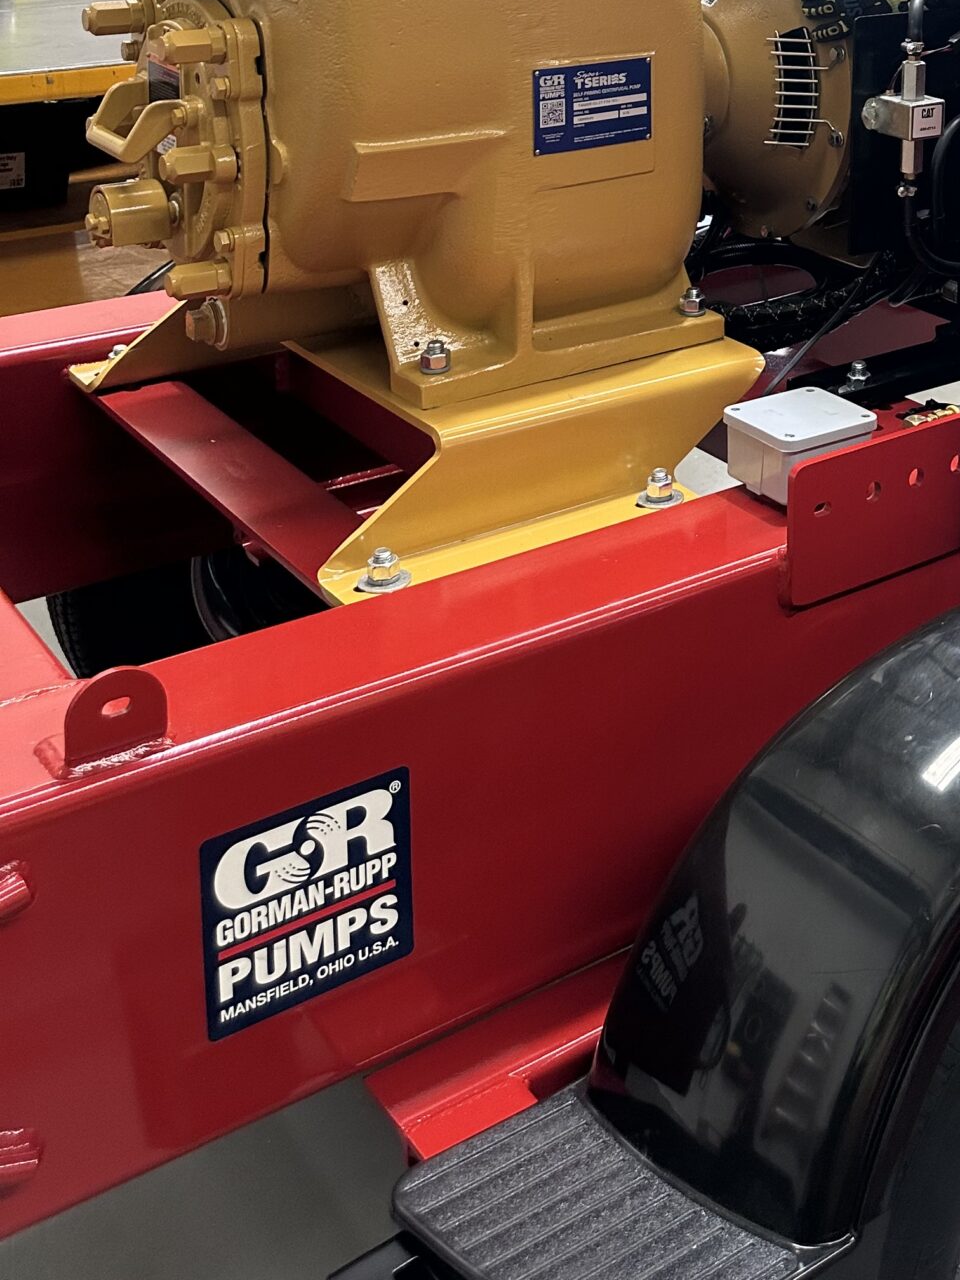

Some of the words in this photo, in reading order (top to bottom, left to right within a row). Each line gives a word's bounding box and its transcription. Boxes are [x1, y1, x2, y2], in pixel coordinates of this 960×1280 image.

[540, 91, 565, 100] PUMPS
[921, 107, 936, 119] CAT
[216, 852, 397, 947] GORMAN-RUPP
[218, 894, 399, 1003] PUMPS
[219, 972, 314, 1023] MANSFIELD,
[316, 953, 355, 979] OHIO
[358, 937, 400, 961] U.S.A.
